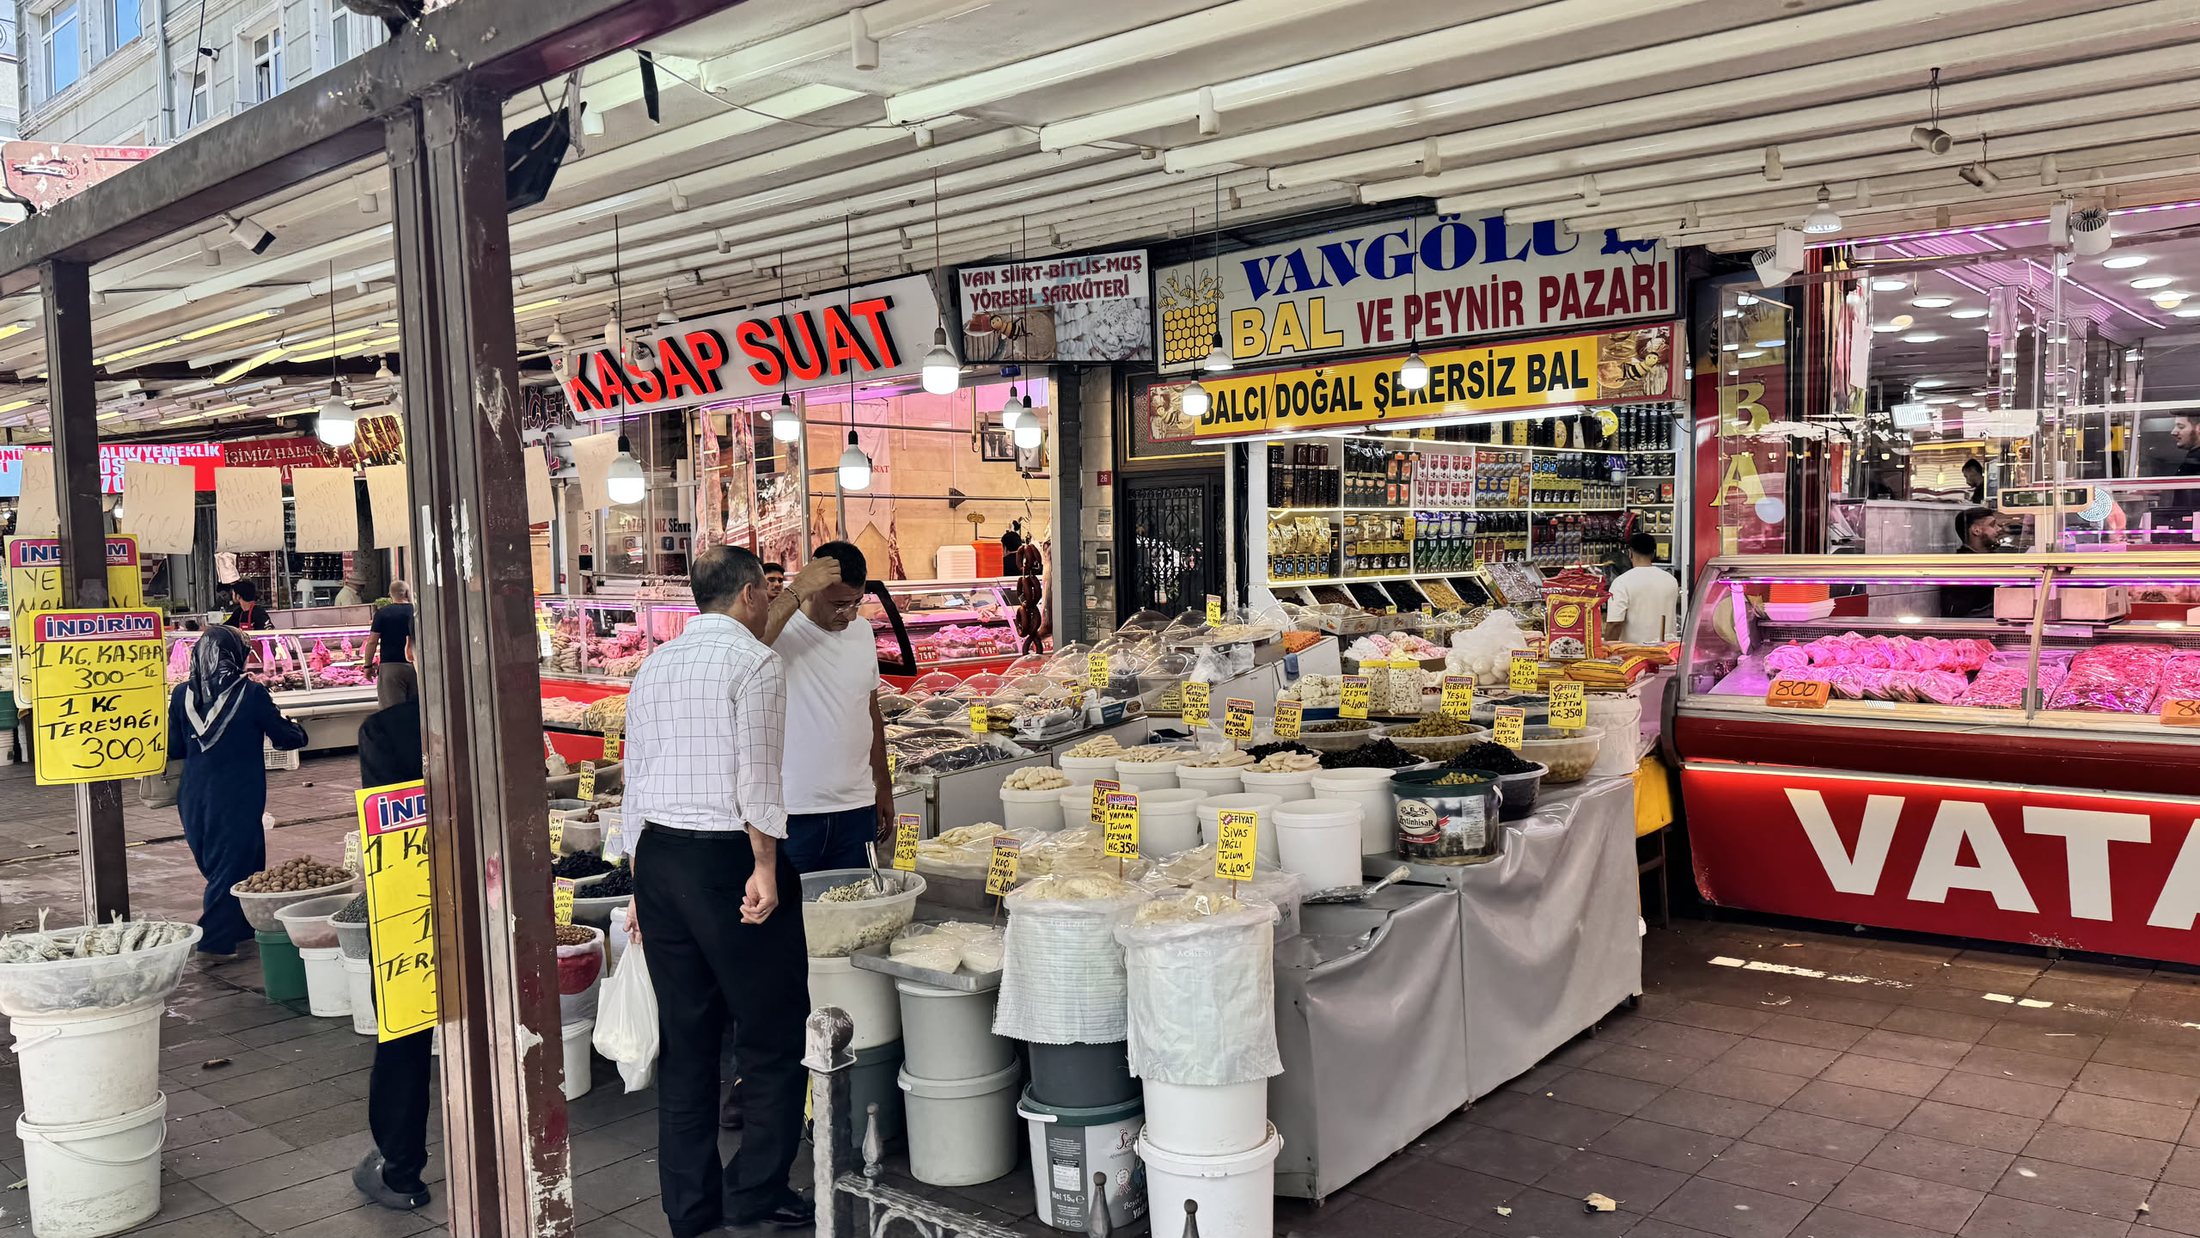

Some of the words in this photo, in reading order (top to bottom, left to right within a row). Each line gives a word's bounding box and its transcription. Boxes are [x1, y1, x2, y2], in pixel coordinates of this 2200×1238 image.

[961, 271, 996, 288] VAN
[1230, 296, 1344, 360] BAL
[1356, 298, 1394, 344] VE
[1404, 273, 1524, 340] PEYNİR
[1539, 261, 1668, 323] PAZARI
[565, 328, 729, 413] KASAP
[736, 295, 903, 386] SUAT
[1201, 386, 1266, 426] BALCI
[1276, 370, 1362, 417] DOĞAL
[1527, 350, 1588, 394] BAL
[1100, 475, 1108, 483] 26
[45, 616, 154, 639] İNDİRİM
[1775, 680, 1818, 697] 800
[1553, 692, 1577, 701] YEŞİL
[58, 697, 79, 718] 1
[92, 695, 122, 713] KG
[1550, 701, 1581, 709] ZEYTİN
[39, 709, 159, 741] TEREYAĞI
[1107, 803, 1137, 812] ERZURUM
[1109, 812, 1134, 821] YAPRAK
[1107, 832, 1133, 841] PEYNİR
[1223, 826, 1249, 838] SİVAS
[1220, 838, 1242, 850] YAĞLI
[990, 867, 1014, 878] PEYNİR
